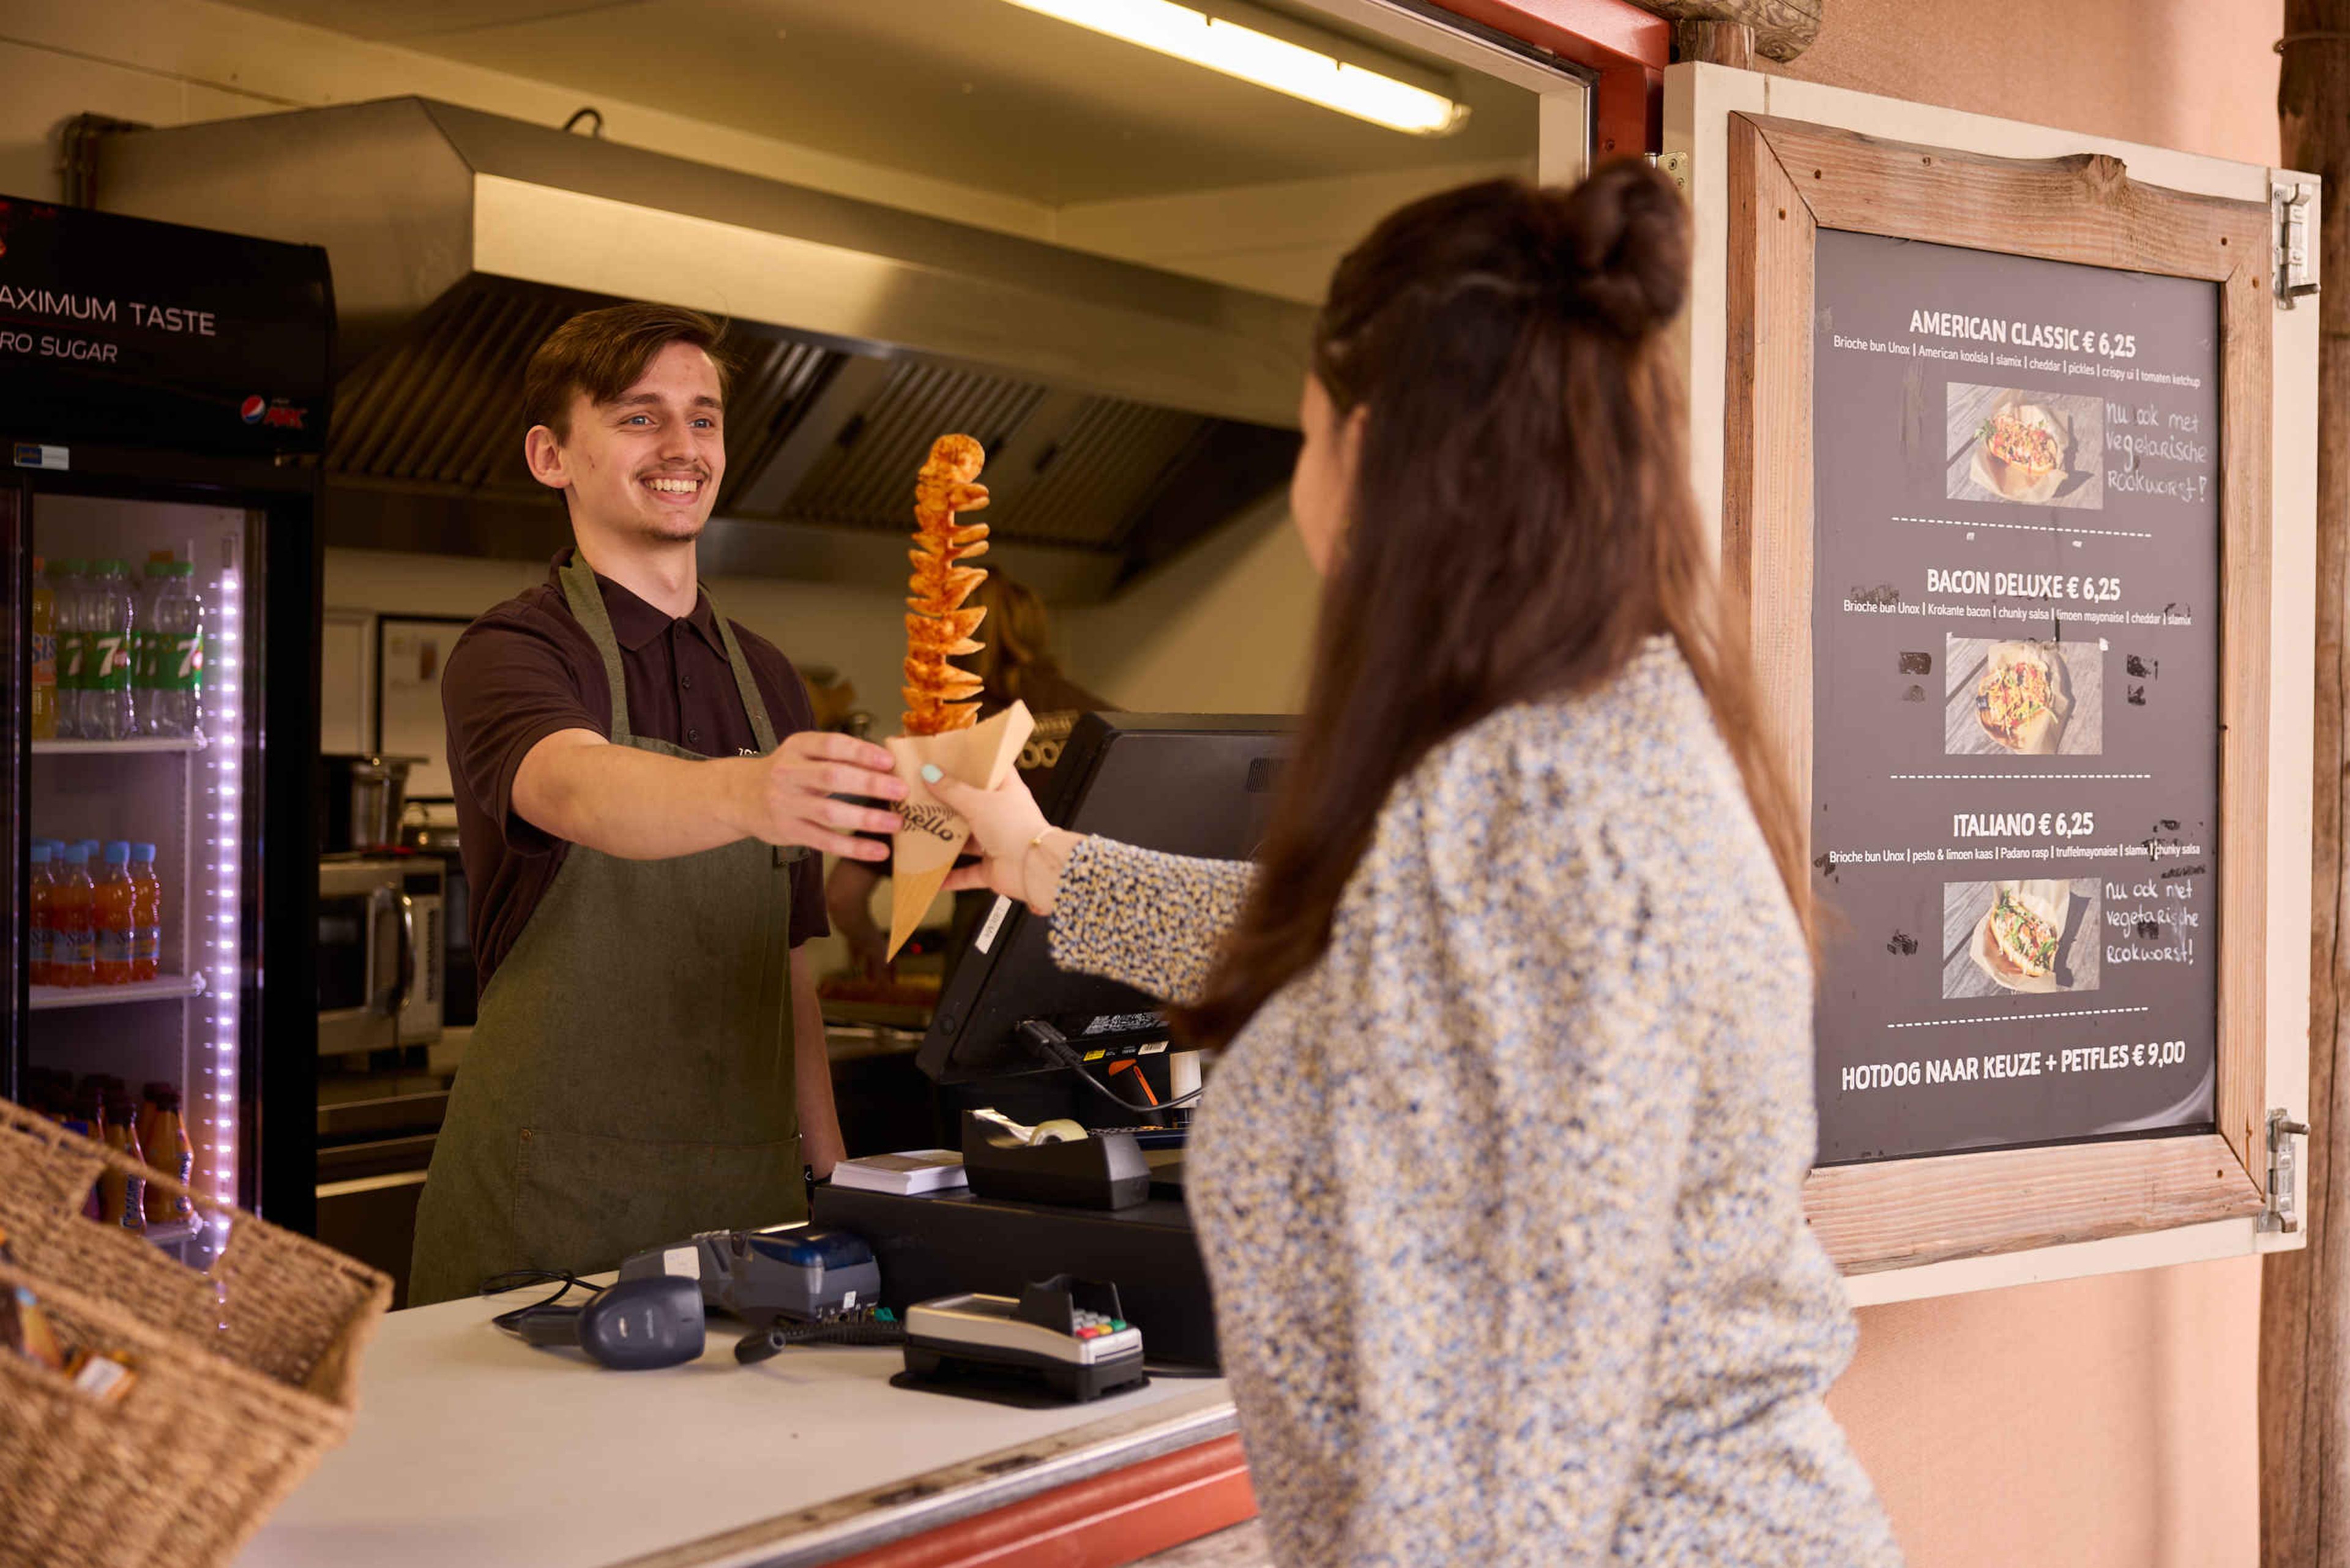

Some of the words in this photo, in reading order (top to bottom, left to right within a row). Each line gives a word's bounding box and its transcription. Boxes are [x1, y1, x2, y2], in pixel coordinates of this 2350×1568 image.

[129, 302, 216, 337] TASTE
[1909, 310, 2006, 343] AMERICAN
[2012, 322, 2079, 351] CLASSIC
[2082, 331, 2095, 353] €
[2098, 332, 2136, 359] 6,25
[40, 336, 118, 363] SUGAR
[1833, 335, 1868, 351] Brioche
[1870, 337, 1886, 352] bun
[1888, 342, 1910, 356] Unox
[1918, 346, 1958, 361] American
[1960, 349, 1988, 364] koolsla
[1996, 354, 2022, 367] slamix
[2029, 359, 2061, 371] cheddar
[2068, 362, 2094, 375] pickles
[2102, 365, 2126, 381] crispy
[2127, 368, 2134, 379] ui
[2141, 370, 2171, 384] tomaten
[2172, 373, 2201, 390] ketchup
[2136, 403, 2159, 427] ook
[2168, 413, 2198, 433] met
[1928, 569, 1989, 594] BACON
[1995, 572, 2063, 598] DELUXE
[2067, 577, 2080, 599] €
[2083, 577, 2121, 603] 6,25
[1843, 600, 1877, 613] Brioche
[1879, 601, 1895, 613] bun
[1898, 602, 1920, 614] Unox
[1928, 603, 1964, 616] Krokante
[1966, 605, 1990, 617] bacon
[1999, 606, 2026, 622] chunky
[2029, 608, 2049, 620] salsa
[2057, 609, 2082, 621] limoen
[2084, 611, 2124, 625] mayonaise
[2132, 613, 2160, 625] cheddar
[2168, 614, 2191, 625] slamix
[1953, 813, 2035, 837] ITALIANO
[2039, 813, 2051, 836] €
[2055, 812, 2094, 839] 6,25
[1830, 851, 1862, 864] Brioche
[1865, 850, 1881, 862] bun
[1883, 849, 1904, 862] Unox
[1912, 849, 1935, 864] pesto
[1937, 849, 1944, 861] &
[1946, 848, 1973, 861] limoen
[1975, 848, 1993, 860] kaas
[2001, 847, 2031, 859] Padano
[2032, 849, 2049, 860] rasp
[2056, 845, 2117, 859] truffelmayonaise
[2124, 844, 2147, 856] slamix
[2154, 843, 2180, 859] chunky
[2182, 843, 2200, 855] salsa
[2133, 879, 2158, 898] ook
[1842, 1062, 1920, 1091] HOTDOG
[1926, 1057, 1979, 1084] NAAR
[1983, 1052, 2041, 1079] KEUZE
[2046, 1055, 2056, 1072] +
[2061, 1044, 2128, 1073] PETFLES
[2132, 1044, 2144, 1066] €
[2147, 1040, 2185, 1067] 9,00
